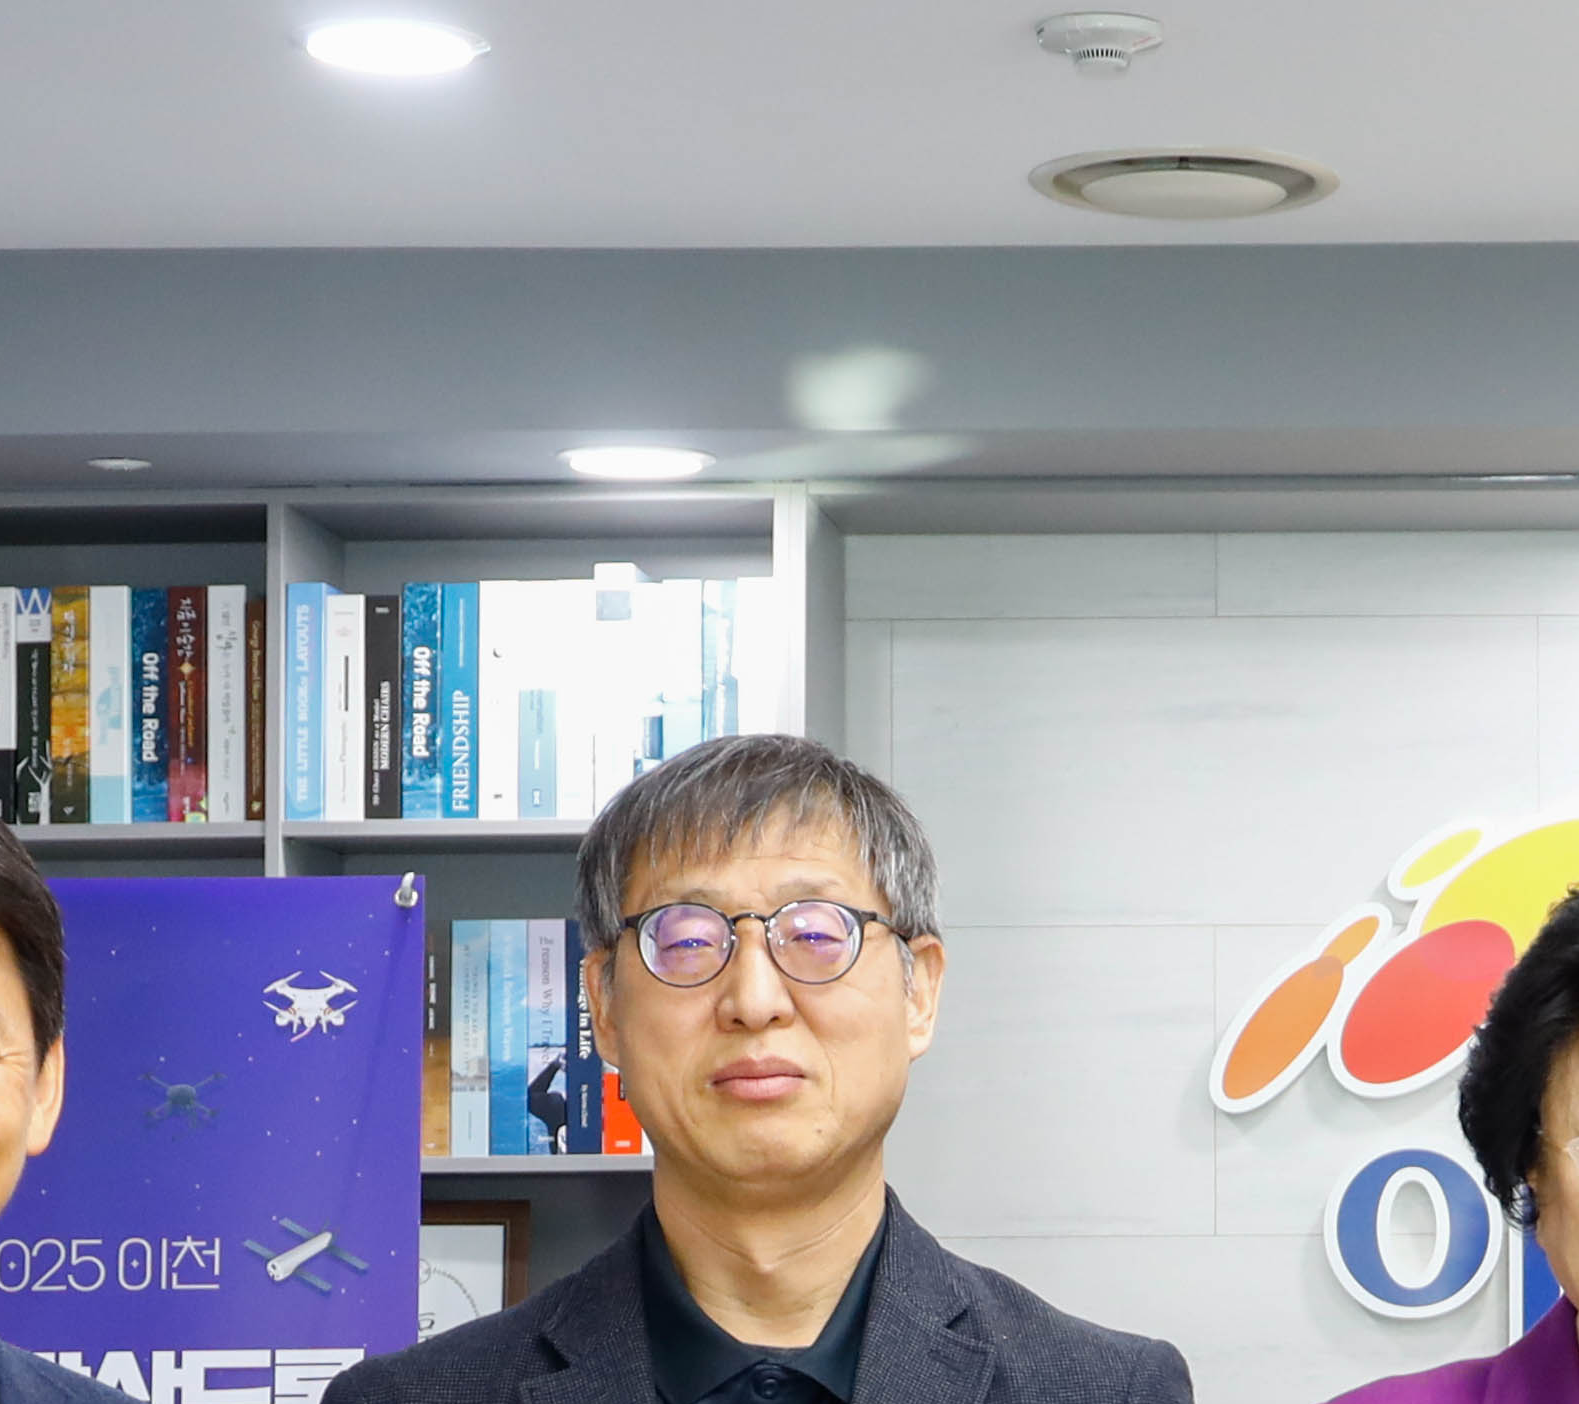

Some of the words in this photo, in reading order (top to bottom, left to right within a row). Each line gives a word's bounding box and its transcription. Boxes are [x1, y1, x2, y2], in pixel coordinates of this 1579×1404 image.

[142, 652, 159, 680] Off
[414, 646, 431, 675] Off
[142, 685, 159, 714] the
[380, 681, 390, 721] CHAIRS
[414, 679, 431, 709] the
[142, 718, 159, 762] Road
[380, 724, 390, 769] MODERN
[414, 712, 431, 757] Road
[452, 689, 470, 811] FRIENDSHIP
[542, 948, 551, 984] reason
[539, 990, 552, 1014] Why
[579, 1013, 591, 1026] in
[578, 1030, 592, 1059] Life
[118, 1235, 220, 1291] 이천
